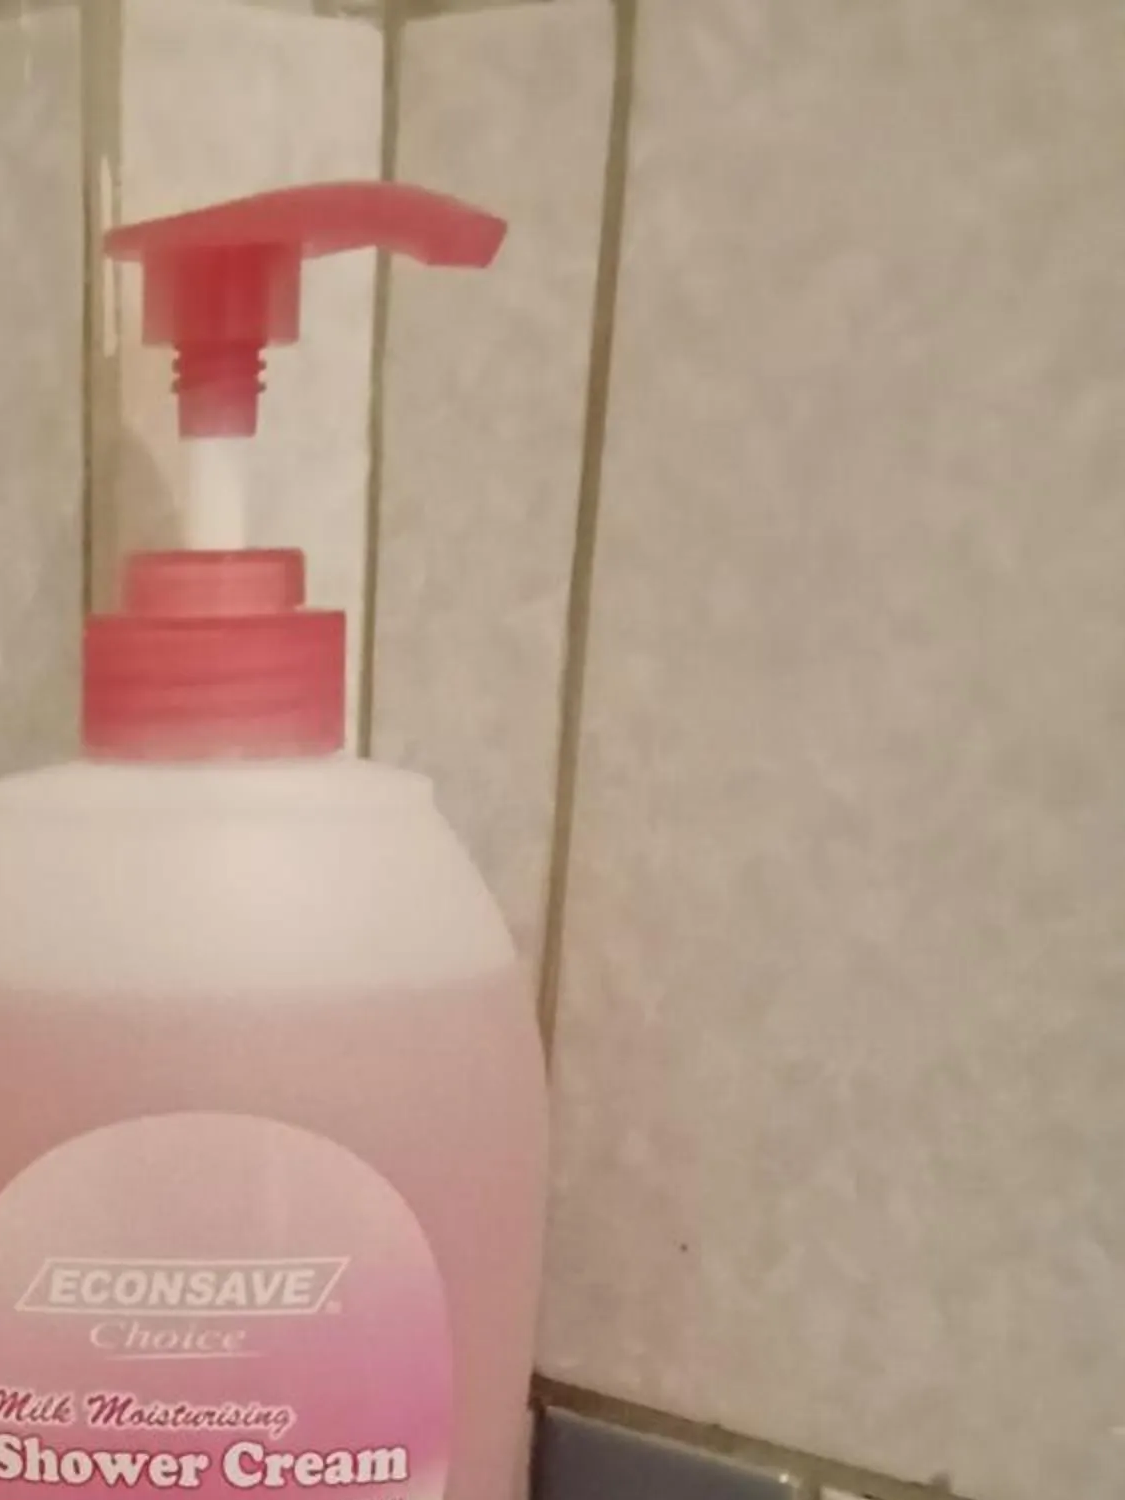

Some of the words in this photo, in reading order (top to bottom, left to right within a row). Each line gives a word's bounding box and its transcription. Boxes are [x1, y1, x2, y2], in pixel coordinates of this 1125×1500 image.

[49, 1268, 314, 1306] ECONSAVE
[89, 1319, 247, 1352] Choice
[87, 1393, 293, 1436] Moisturising
[223, 1442, 409, 1488] Cream
